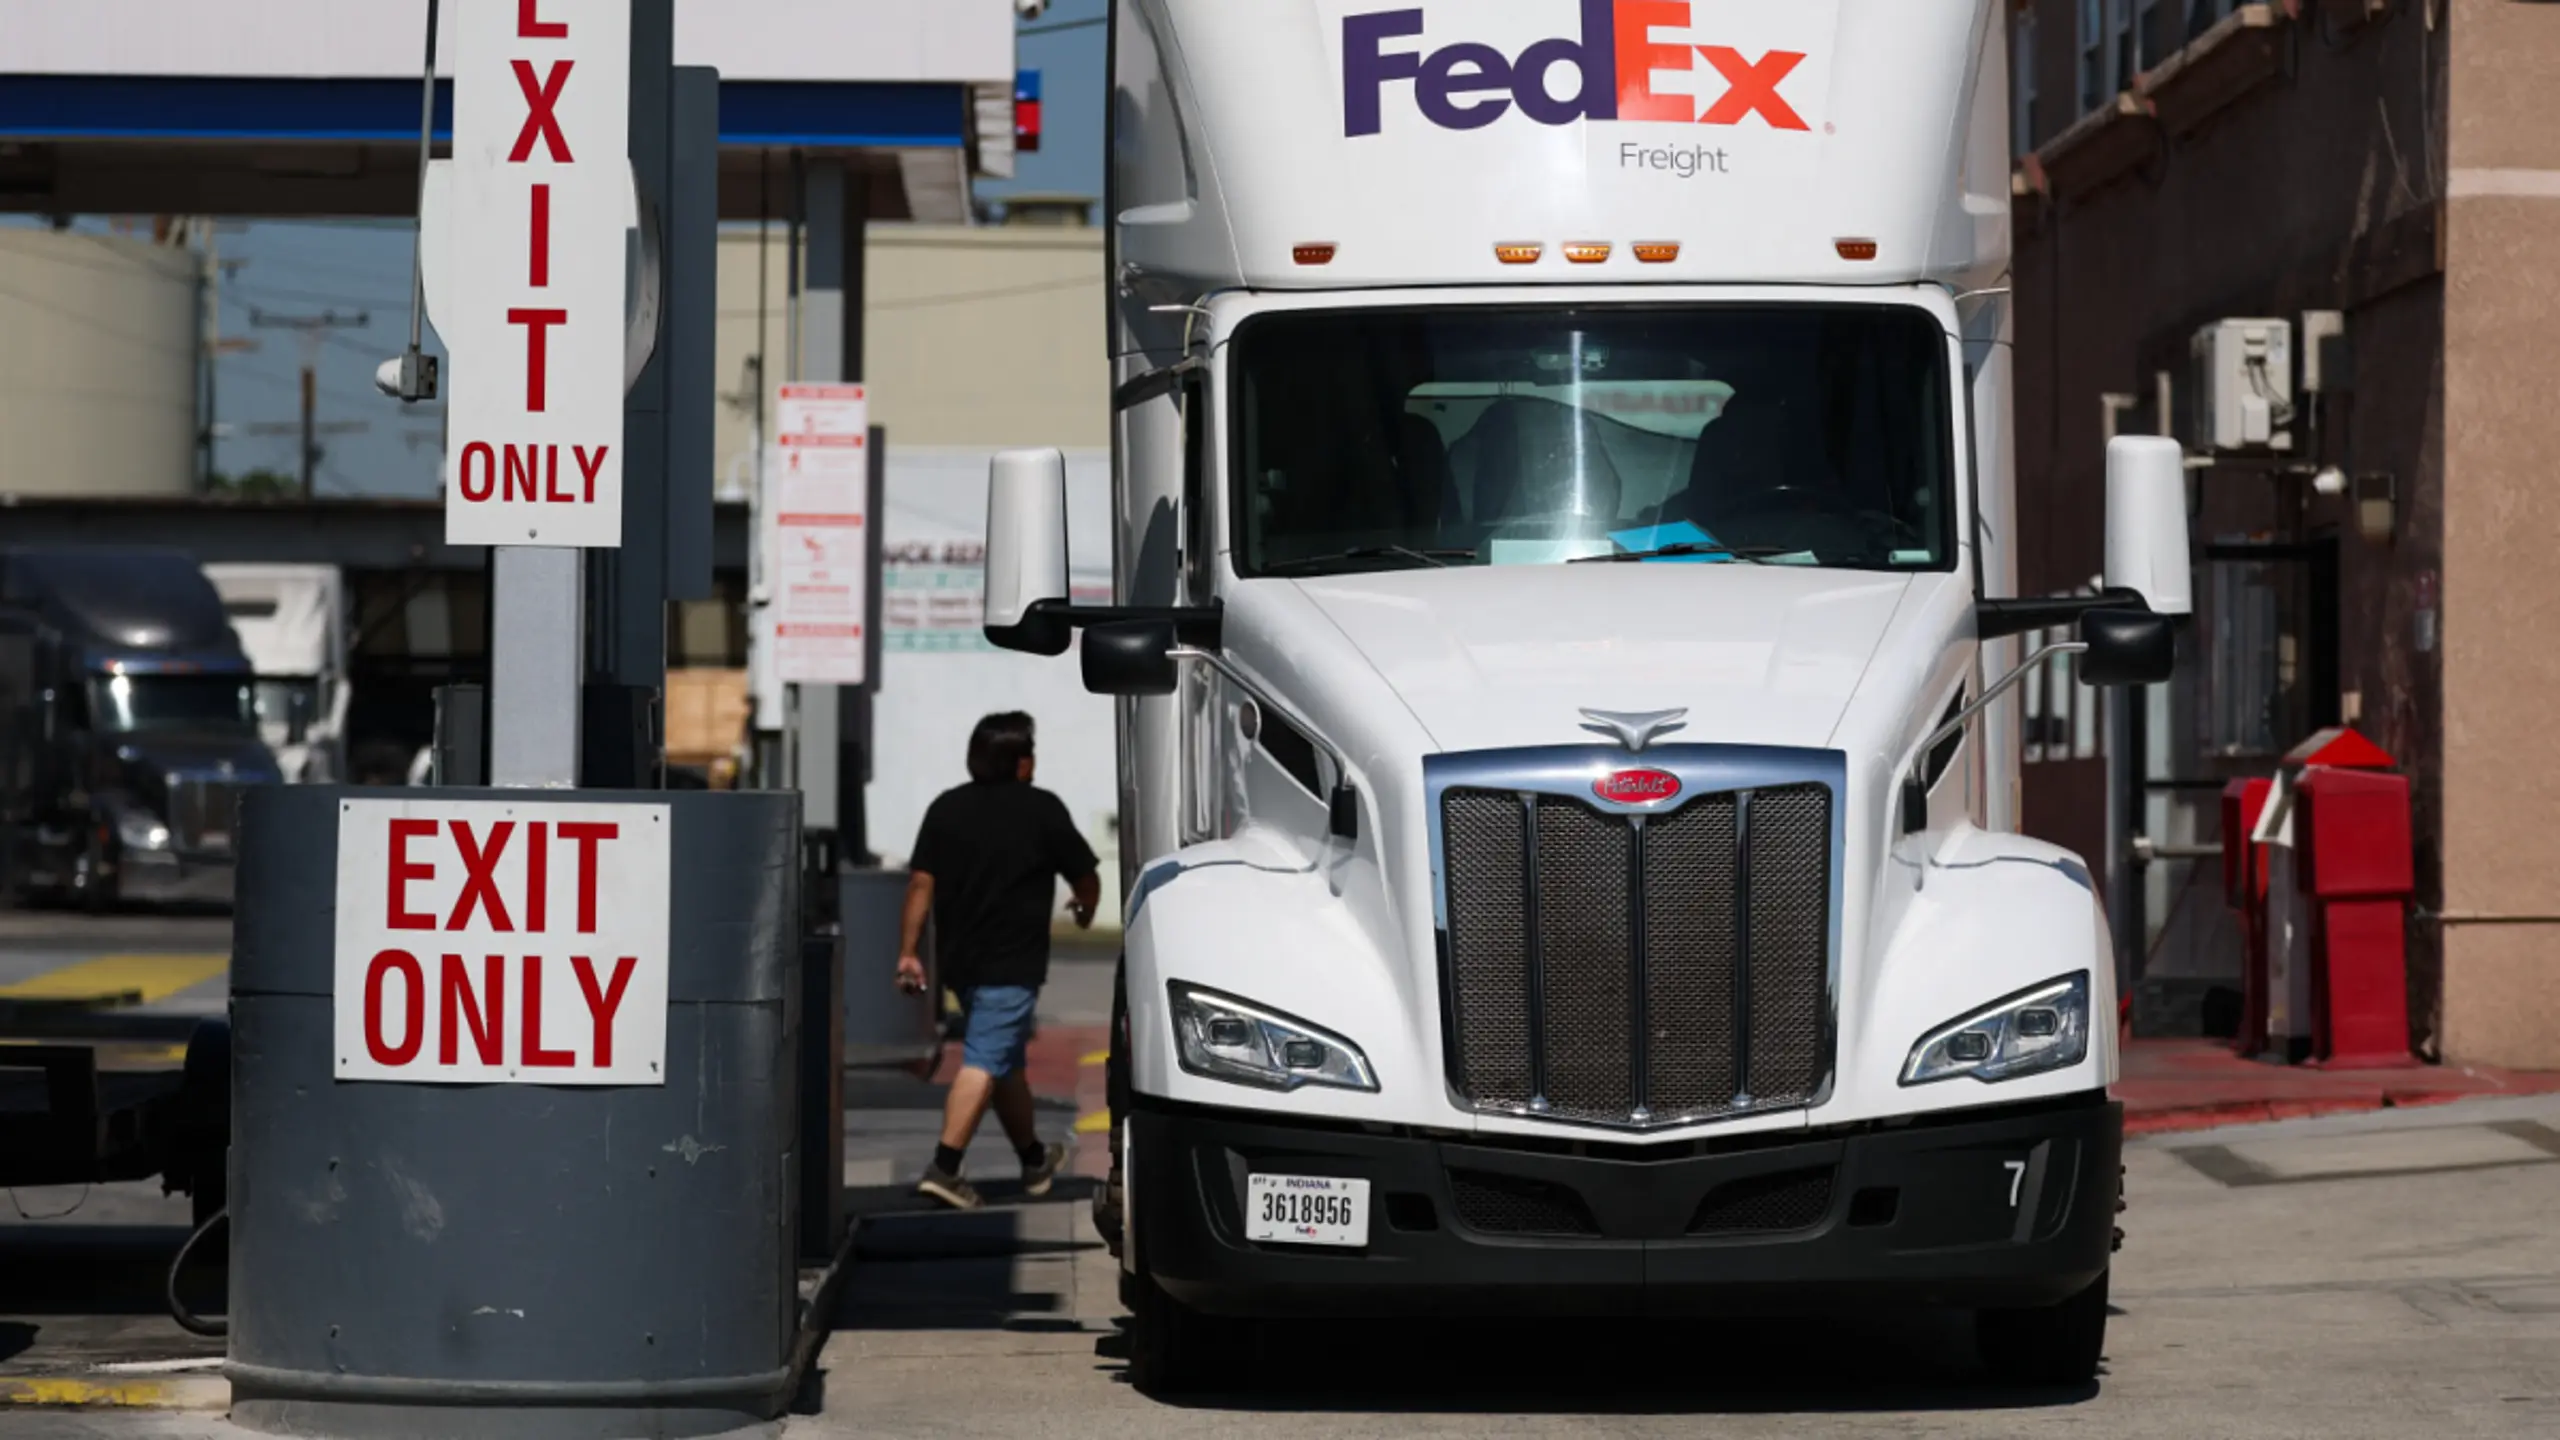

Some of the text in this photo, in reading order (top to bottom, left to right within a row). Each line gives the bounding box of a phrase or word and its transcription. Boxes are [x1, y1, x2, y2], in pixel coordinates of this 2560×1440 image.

[1342, 0, 1811, 138] FedEx
[1620, 142, 1728, 178] Freight
[460, 441, 608, 503] ONLY
[1602, 771, 1668, 795] Peterbilt
[387, 818, 619, 934] EXIT
[364, 949, 637, 1068] ONLY
[1286, 1178, 1332, 1189] INDIANA
[2003, 1160, 2026, 1207] 7
[1262, 1192, 1352, 1226] 3618956
